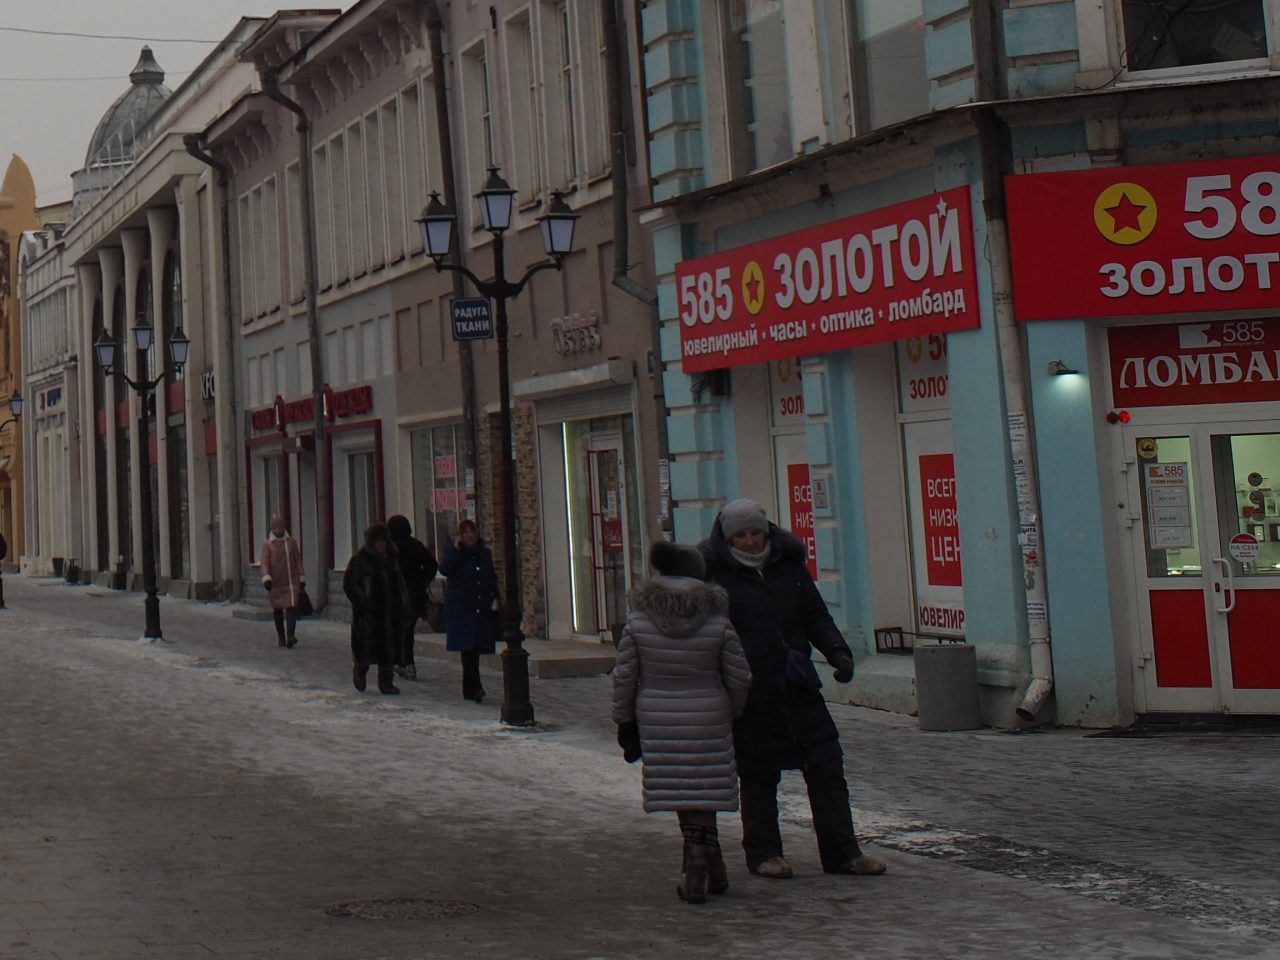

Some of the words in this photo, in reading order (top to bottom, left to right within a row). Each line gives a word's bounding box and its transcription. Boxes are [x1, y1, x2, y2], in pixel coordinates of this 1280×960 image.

[680, 266, 734, 327] 585
[773, 198, 963, 309] ЗОЛОТОЙ
[1099, 252, 1280, 298] ЗОЛОТ
[454, 307, 488, 318] РАДУГА
[684, 323, 758, 356] ювелирный
[770, 319, 807, 342] часы
[819, 307, 874, 334] оптика
[888, 288, 966, 322] ломбард
[455, 320, 490, 333] ТКАНИ
[1223, 322, 1264, 342] 585
[928, 333, 947, 361] 5
[1120, 350, 1280, 389] ЛОМБА
[910, 375, 948, 400] ЗОЛО
[780, 395, 805, 416] ЗОЛ
[1164, 465, 1184, 476] 585
[927, 478, 957, 498] ВСЕГ
